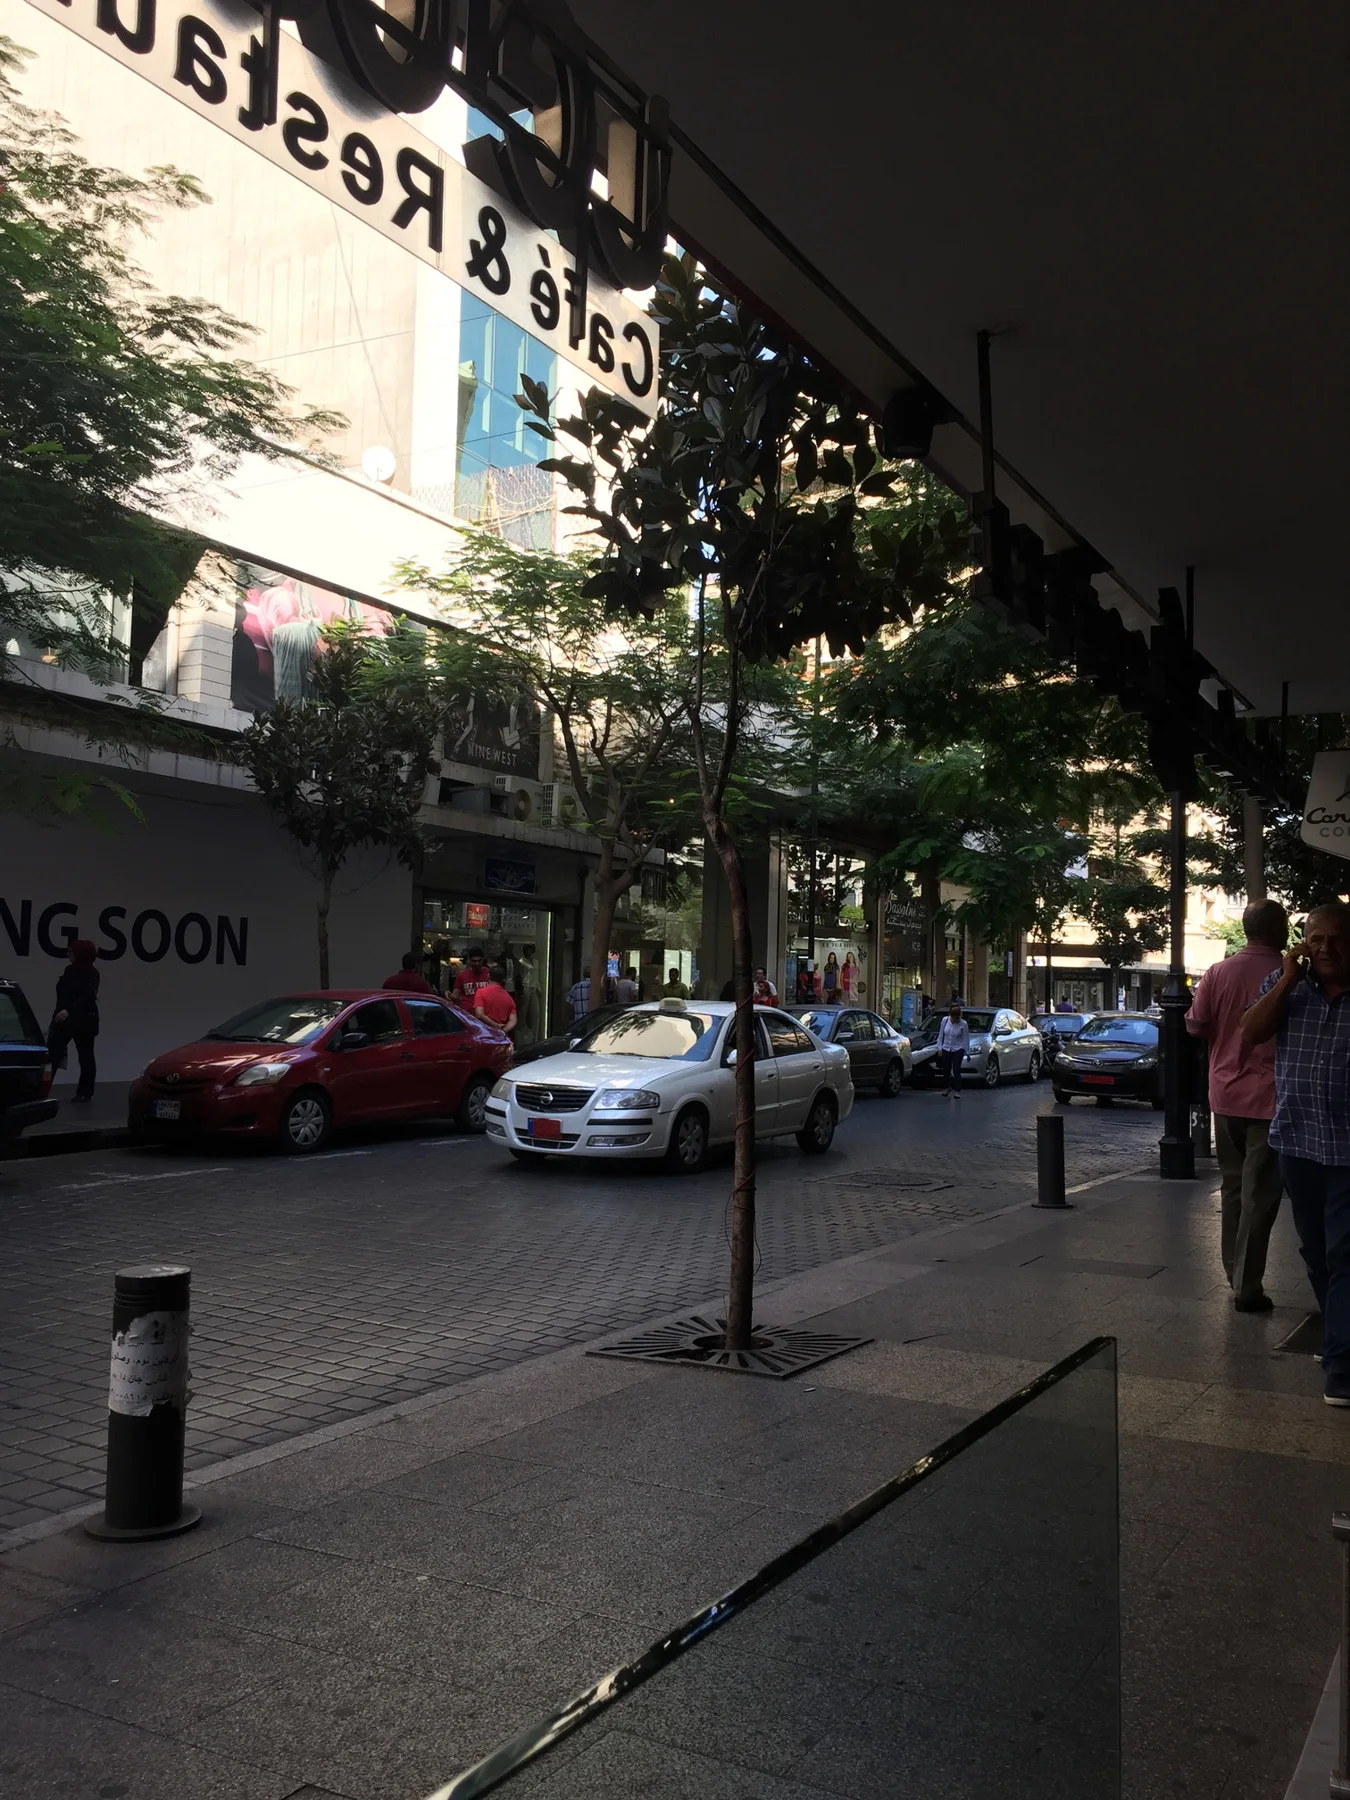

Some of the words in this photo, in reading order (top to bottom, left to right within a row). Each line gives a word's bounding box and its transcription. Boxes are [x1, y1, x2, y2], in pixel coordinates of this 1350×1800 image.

[467, 741, 491, 760] NINE
[493, 749, 517, 767] WEST
[1306, 807, 1350, 824] Car
[1319, 827, 1350, 837] CO
[96, 906, 249, 966] SOON
